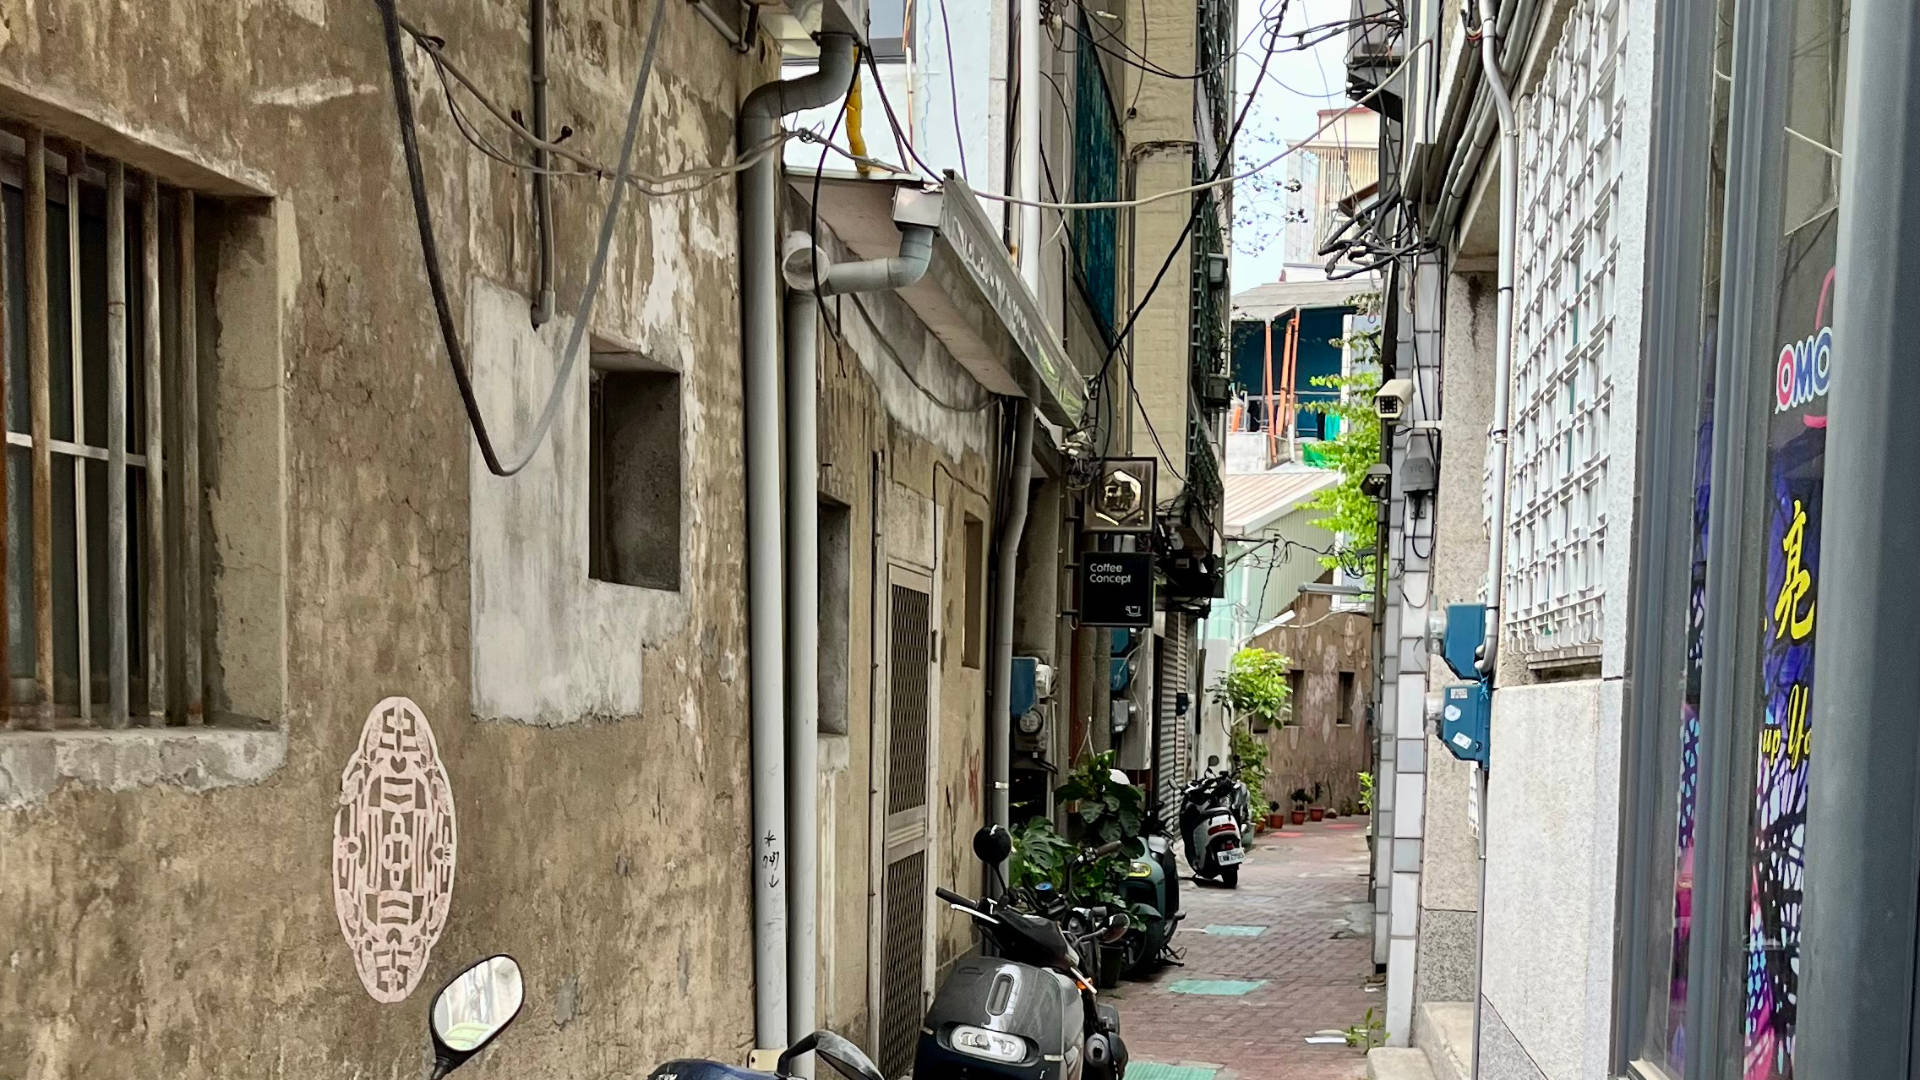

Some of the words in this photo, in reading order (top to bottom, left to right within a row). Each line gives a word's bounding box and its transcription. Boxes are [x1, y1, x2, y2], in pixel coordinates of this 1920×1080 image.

[1089, 562, 1123, 573] Coffee
[1774, 499, 1815, 640] 亮
[1089, 573, 1132, 586] Concept
